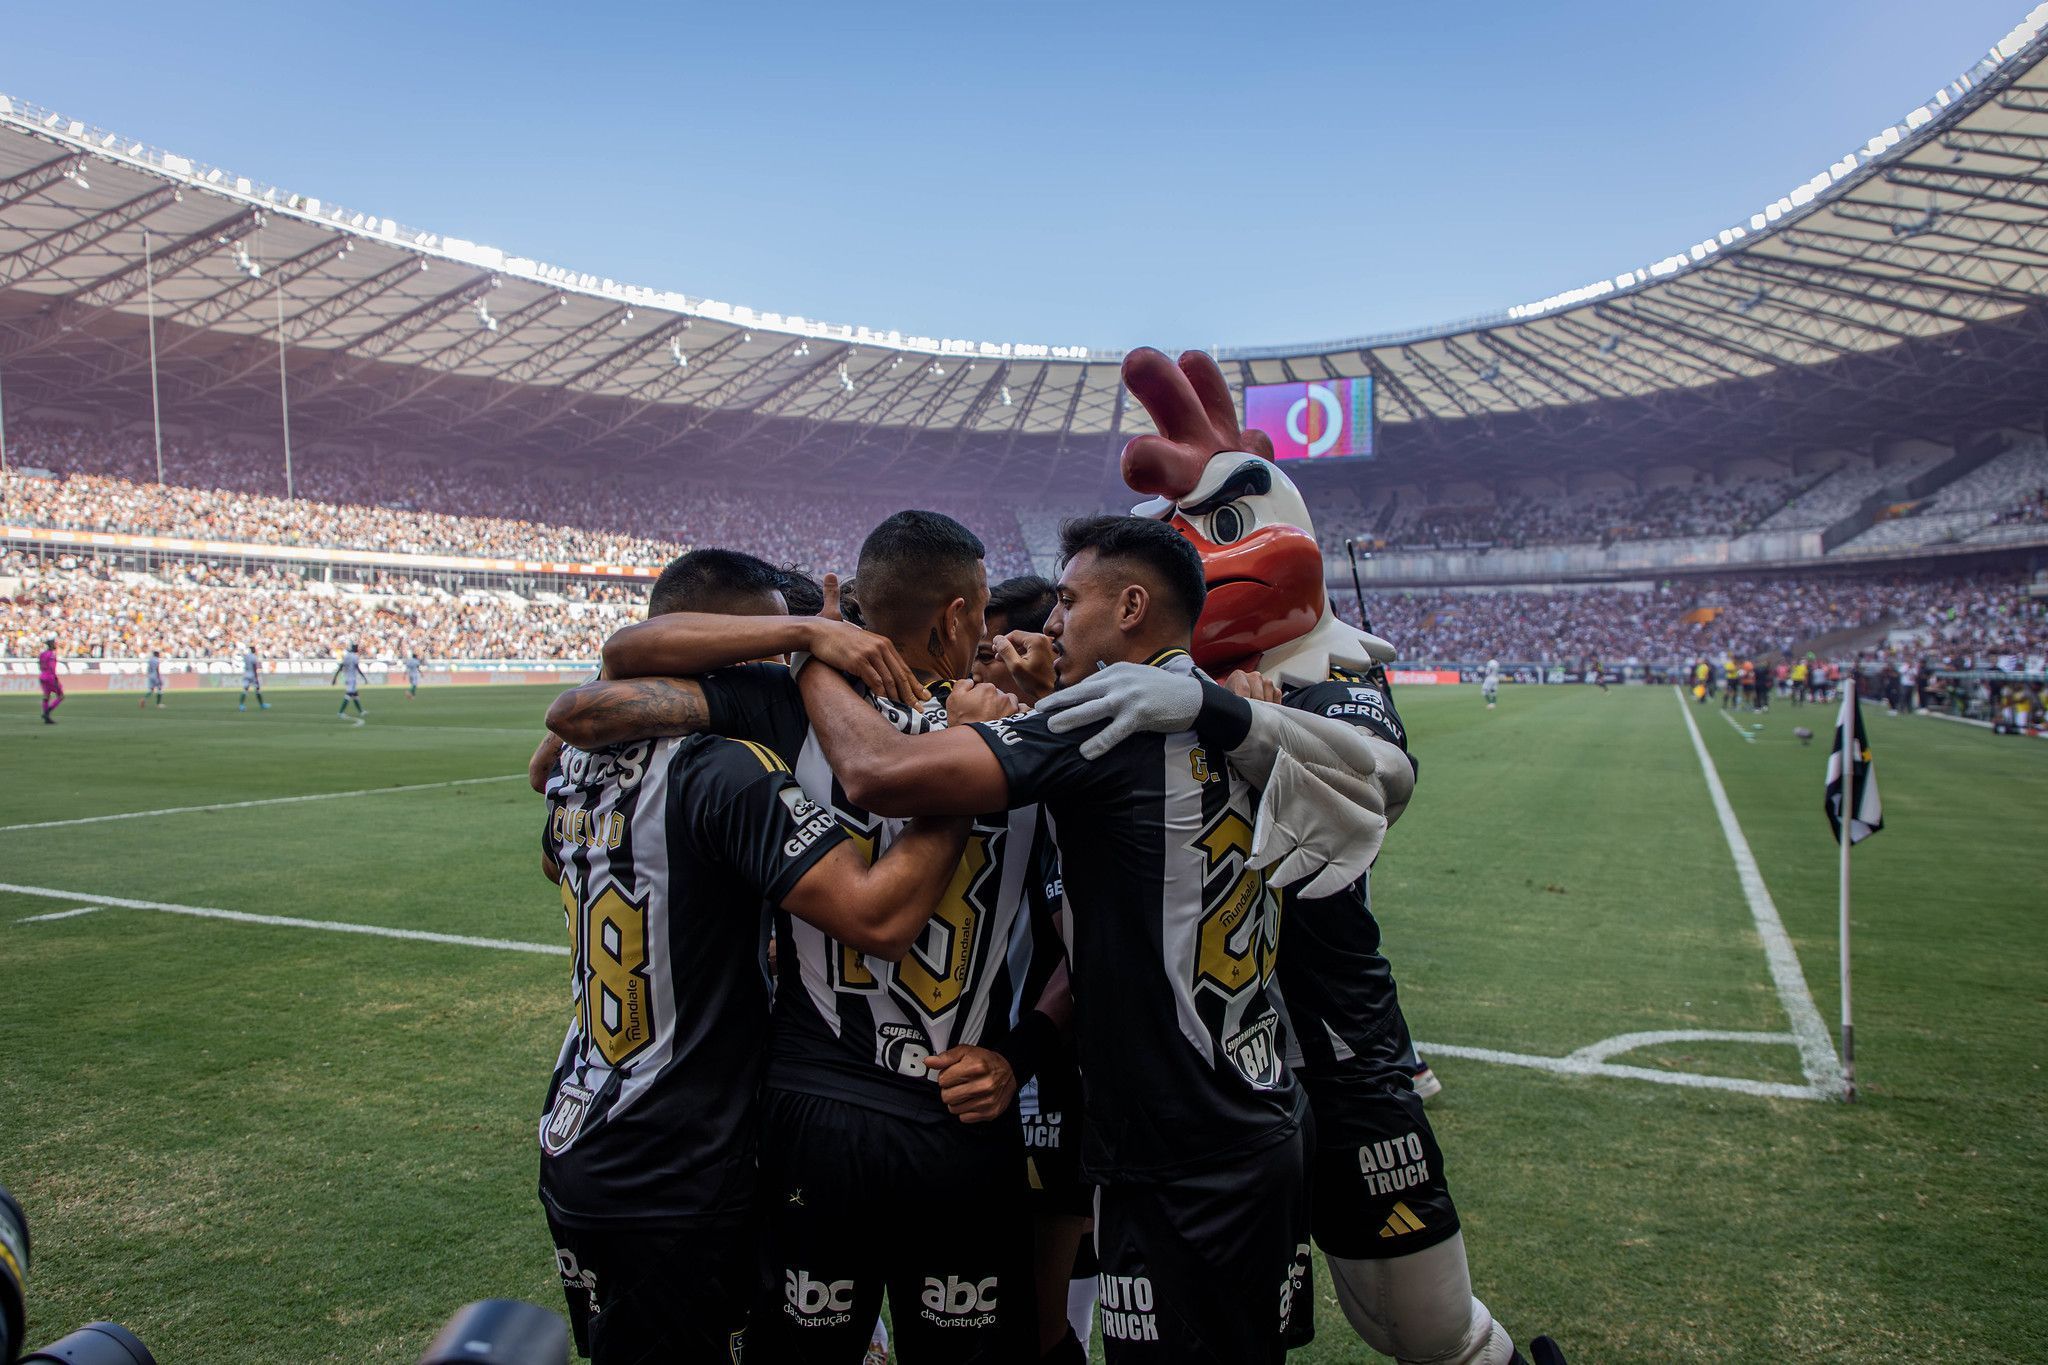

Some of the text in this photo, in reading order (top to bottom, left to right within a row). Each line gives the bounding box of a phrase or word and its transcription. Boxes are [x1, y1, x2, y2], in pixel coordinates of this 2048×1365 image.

[1326, 703, 1402, 740] GERDAU
[1189, 747, 1220, 784] G.
[553, 806, 625, 850] CUELLO
[784, 813, 838, 857] GERD
[1219, 880, 1256, 928] mundiale
[953, 917, 971, 982] mundiale
[625, 979, 642, 1042] mundiale
[1239, 1032, 1269, 1081] BH
[549, 1100, 582, 1138] BH
[1358, 1132, 1424, 1174] AUTO
[1363, 1160, 1430, 1196] TRUCK
[785, 1268, 854, 1314] abc
[921, 1275, 998, 1315] abc
[1100, 1272, 1154, 1312] AUTO
[920, 1309, 996, 1329] da construção
[1101, 1307, 1159, 1341] TRUCK
